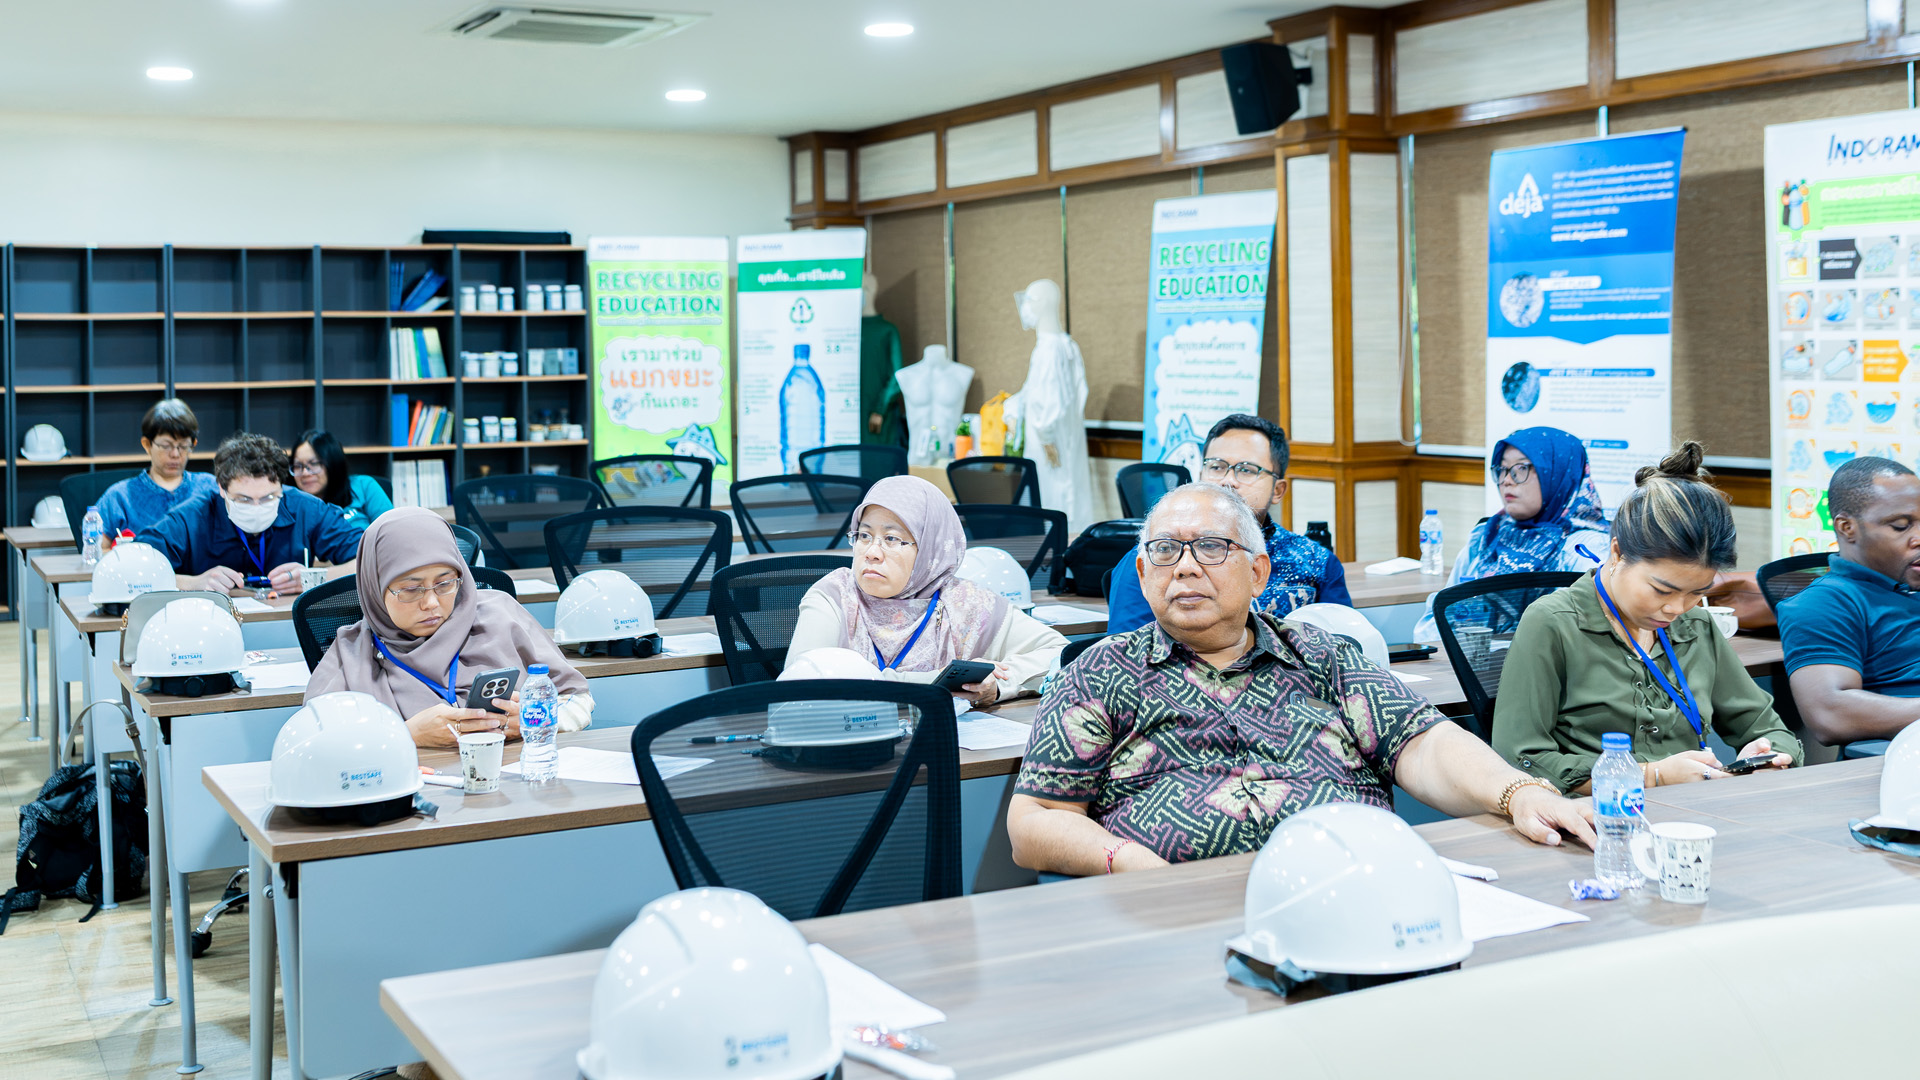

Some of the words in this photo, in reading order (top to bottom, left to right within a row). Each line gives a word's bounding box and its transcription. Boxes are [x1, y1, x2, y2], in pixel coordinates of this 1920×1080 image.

[1159, 241, 1268, 266] RECYCLING
[597, 272, 721, 288] RECYCLING
[1159, 274, 1265, 296] EDUCATION
[597, 297, 721, 313] EDUCATION
[621, 345, 702, 362] เรามาช่วย
[610, 368, 713, 388] แยกขยะ
[640, 392, 700, 409] กันเถอะ
[851, 715, 877, 723] BESTSAFE
[350, 770, 382, 781] BESTSAFE
